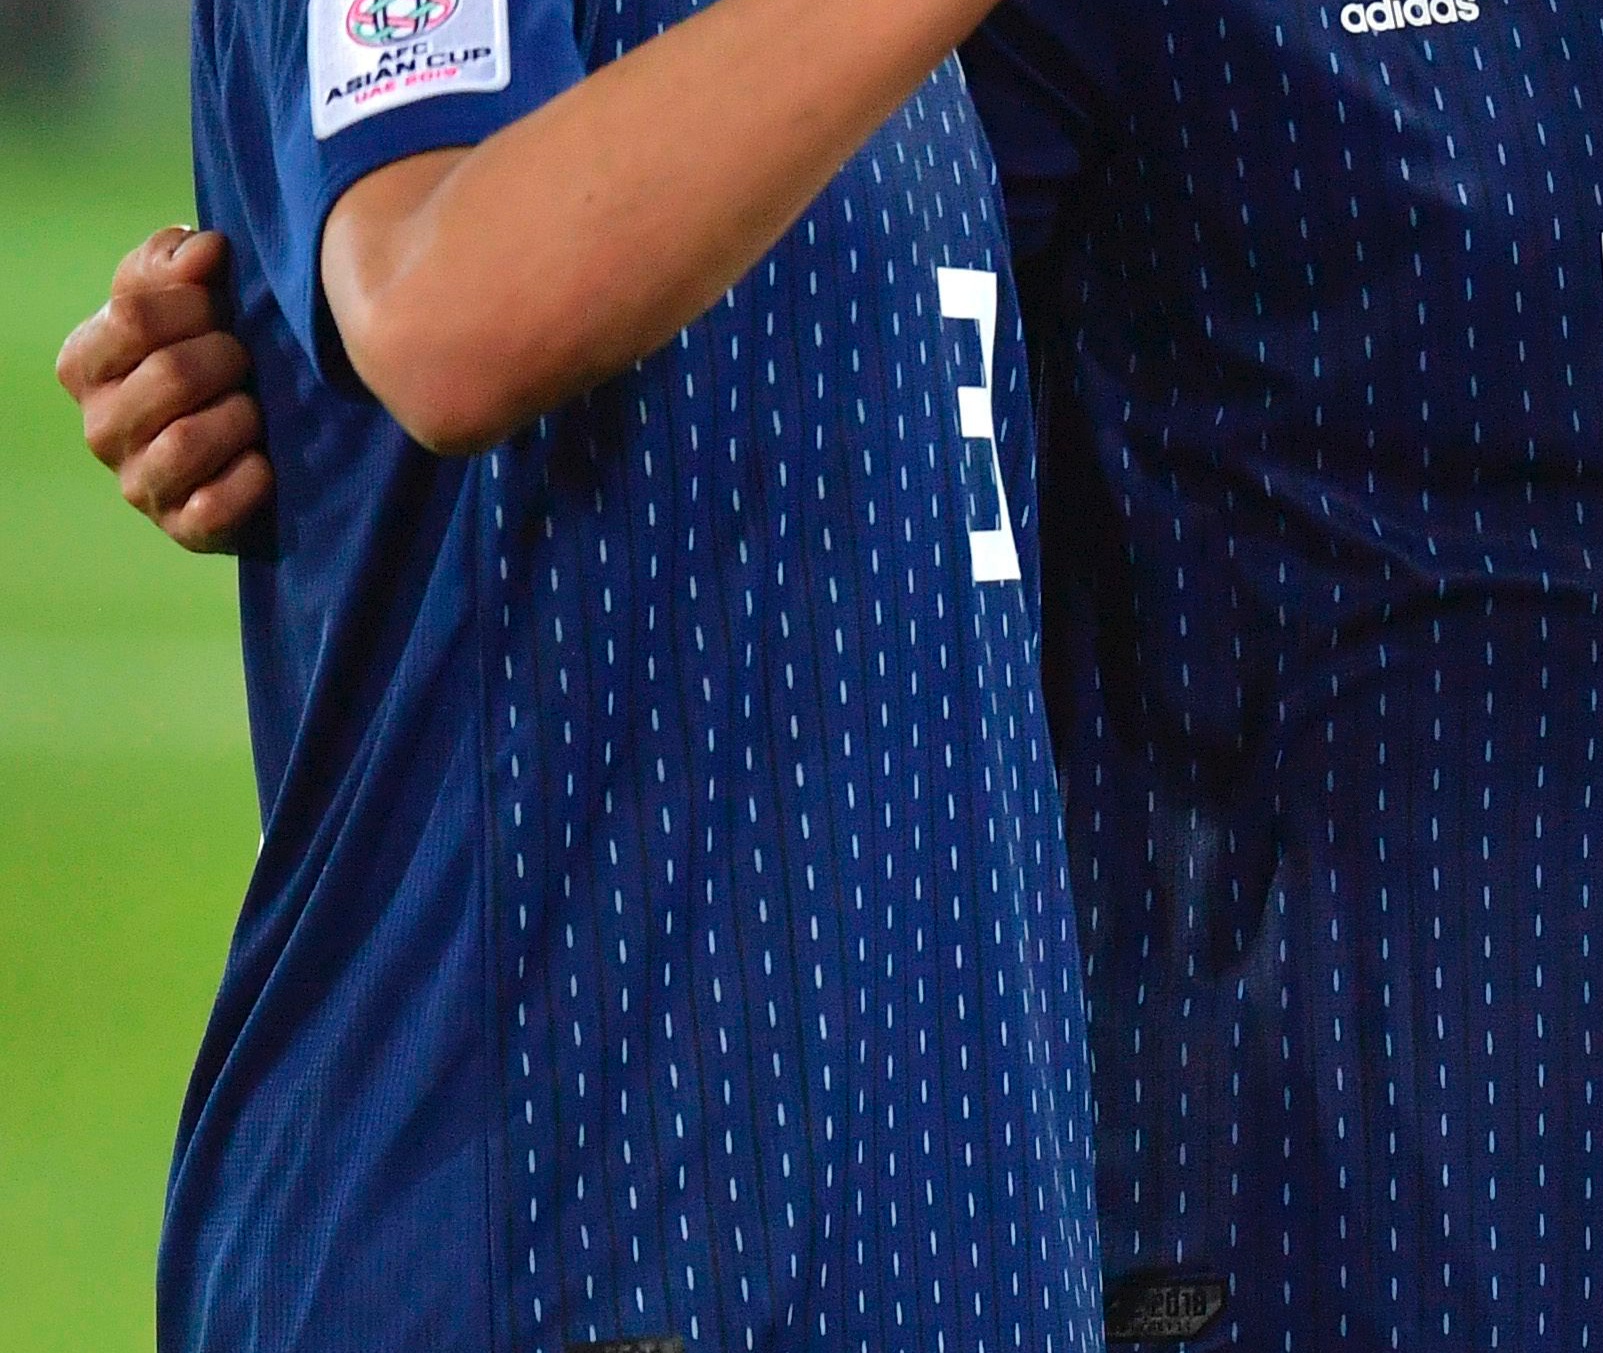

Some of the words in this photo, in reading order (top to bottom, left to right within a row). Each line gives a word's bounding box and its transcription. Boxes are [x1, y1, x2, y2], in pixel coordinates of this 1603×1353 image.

[378, 42, 428, 64] AFC
[325, 59, 415, 105] ASIAN
[427, 48, 491, 68] CUP
[354, 80, 396, 104] UAE
[937, 266, 1021, 582] 3
